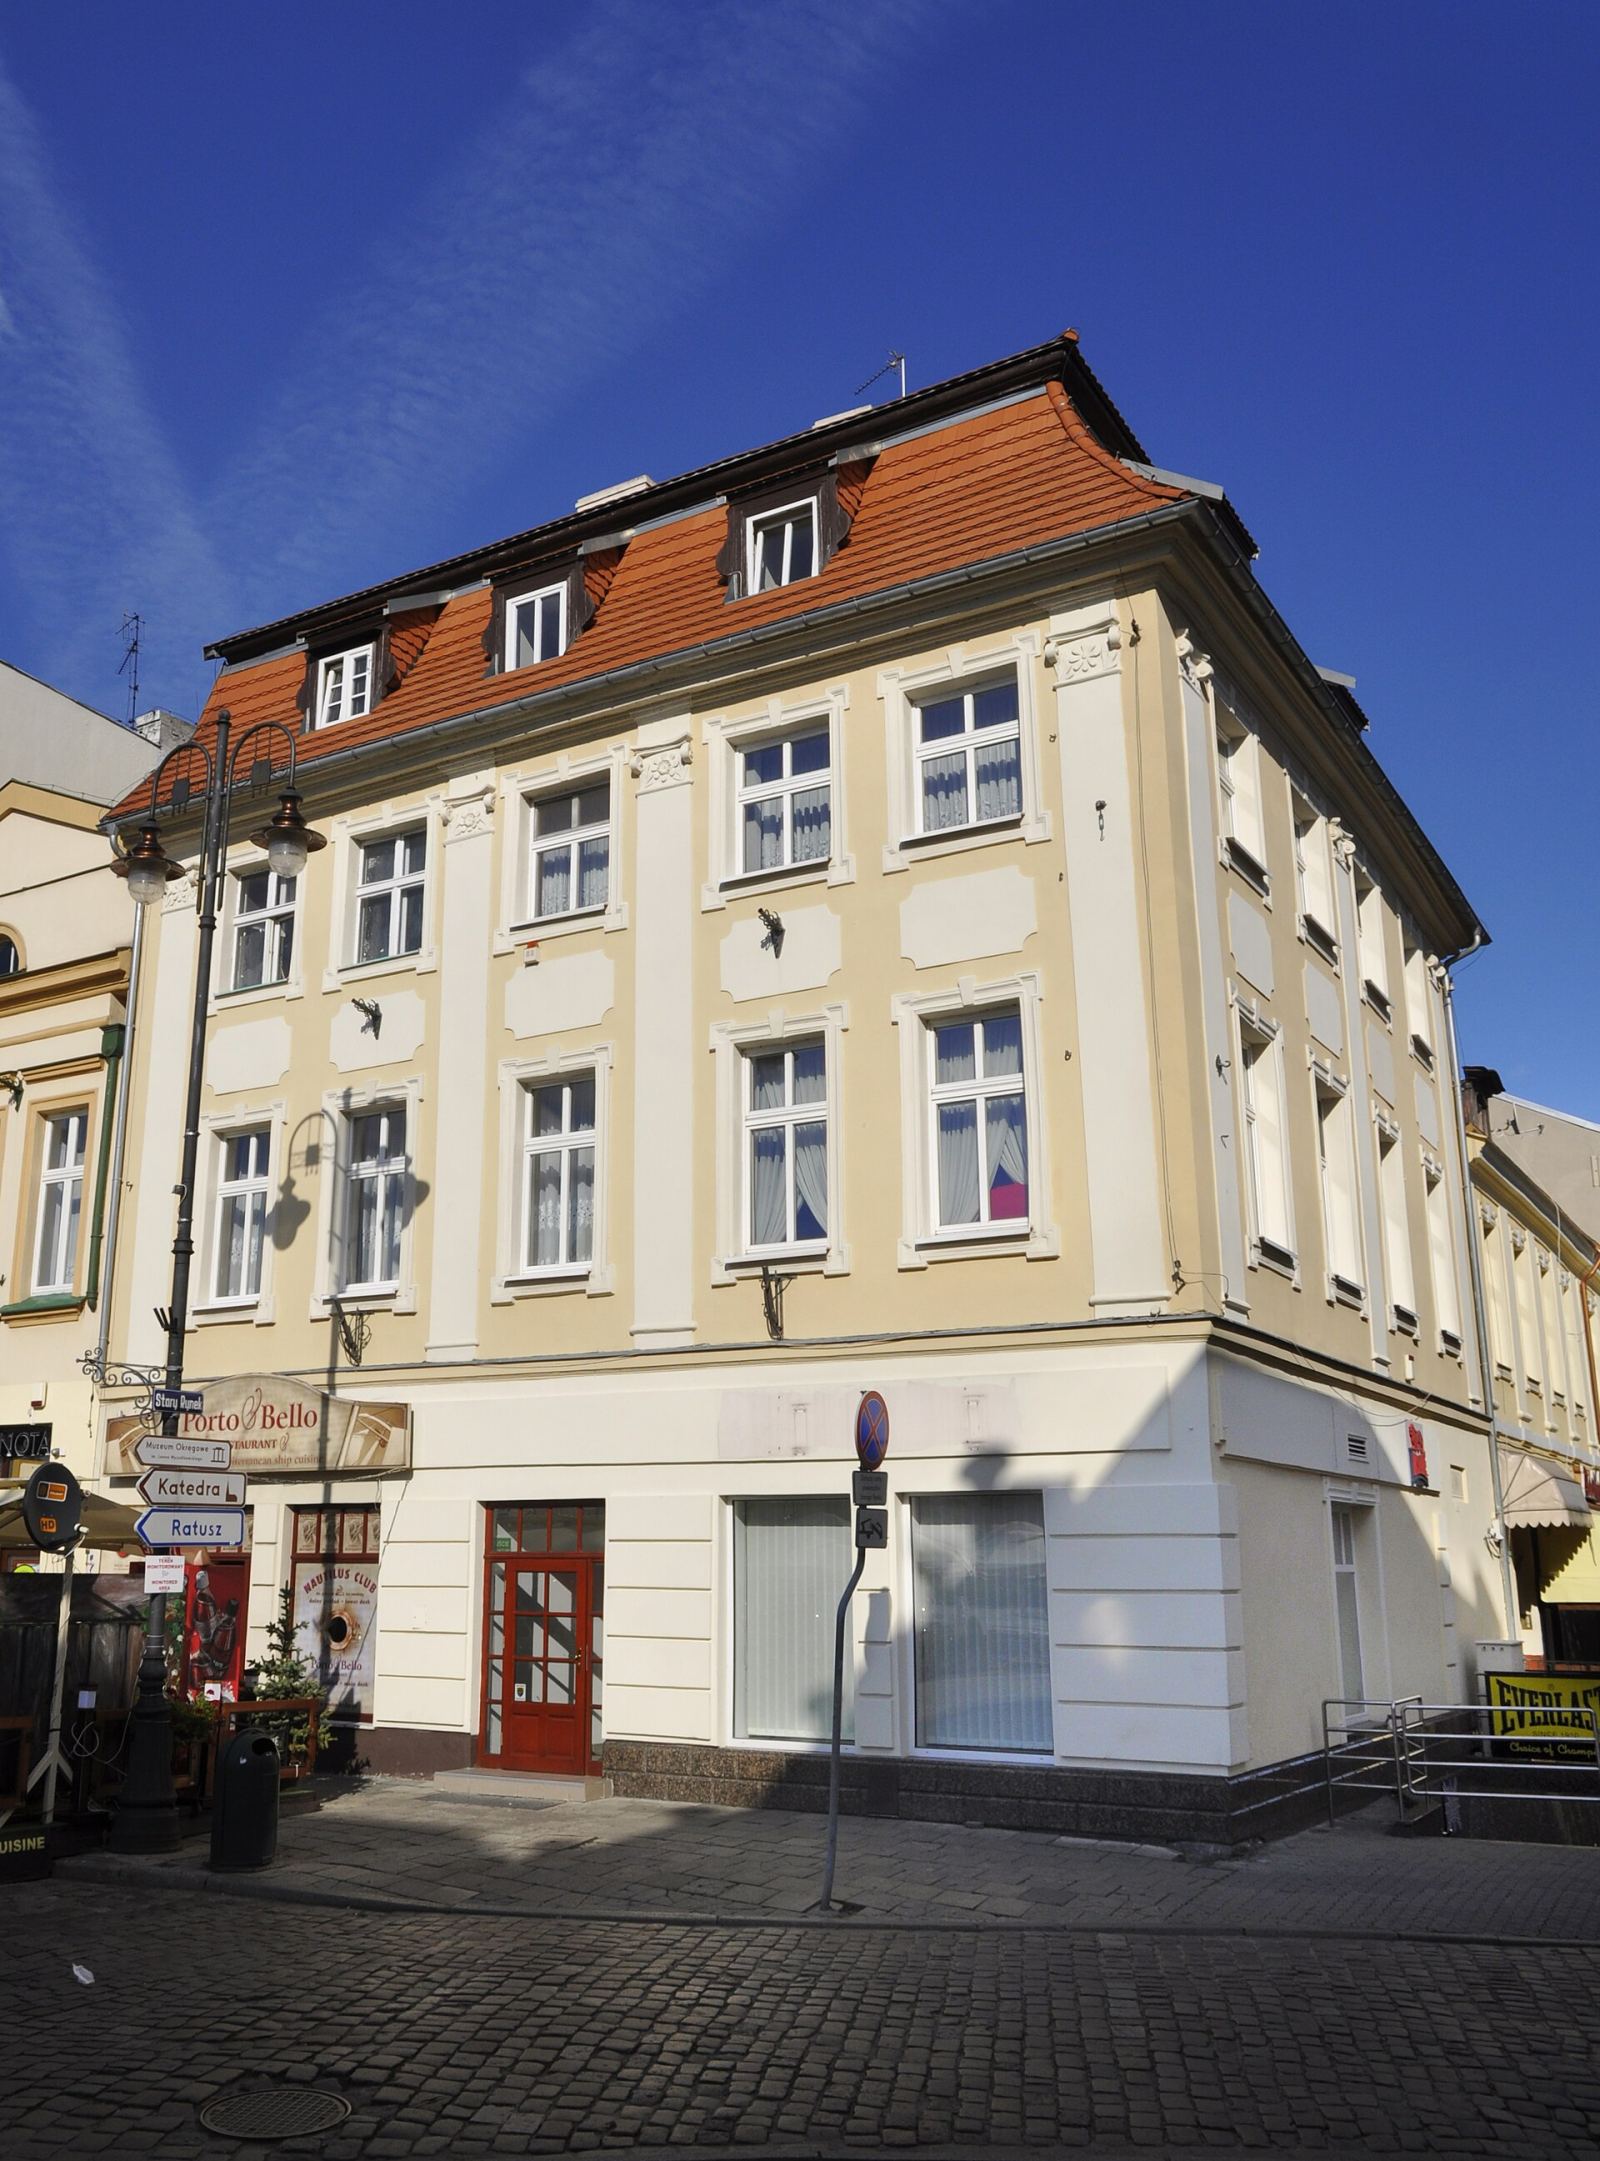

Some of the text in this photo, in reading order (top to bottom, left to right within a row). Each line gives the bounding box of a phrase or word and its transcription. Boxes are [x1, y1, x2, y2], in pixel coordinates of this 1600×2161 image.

[155, 1393, 202, 1411] Stary Rynek
[183, 1402, 318, 1432] Porto Bello
[146, 1441, 173, 1450] Muzeum
[158, 1478, 220, 1496] Katedra
[41, 1519, 55, 1530] HD
[171, 1520, 222, 1536] Ratusz
[354, 1571, 377, 1594] CLUB
[341, 1661, 362, 1671] Bello
[1509, 1742, 1542, 1753] Choice
[1543, 1743, 1554, 1757] of
[0, 1836, 45, 1854] UISINE
